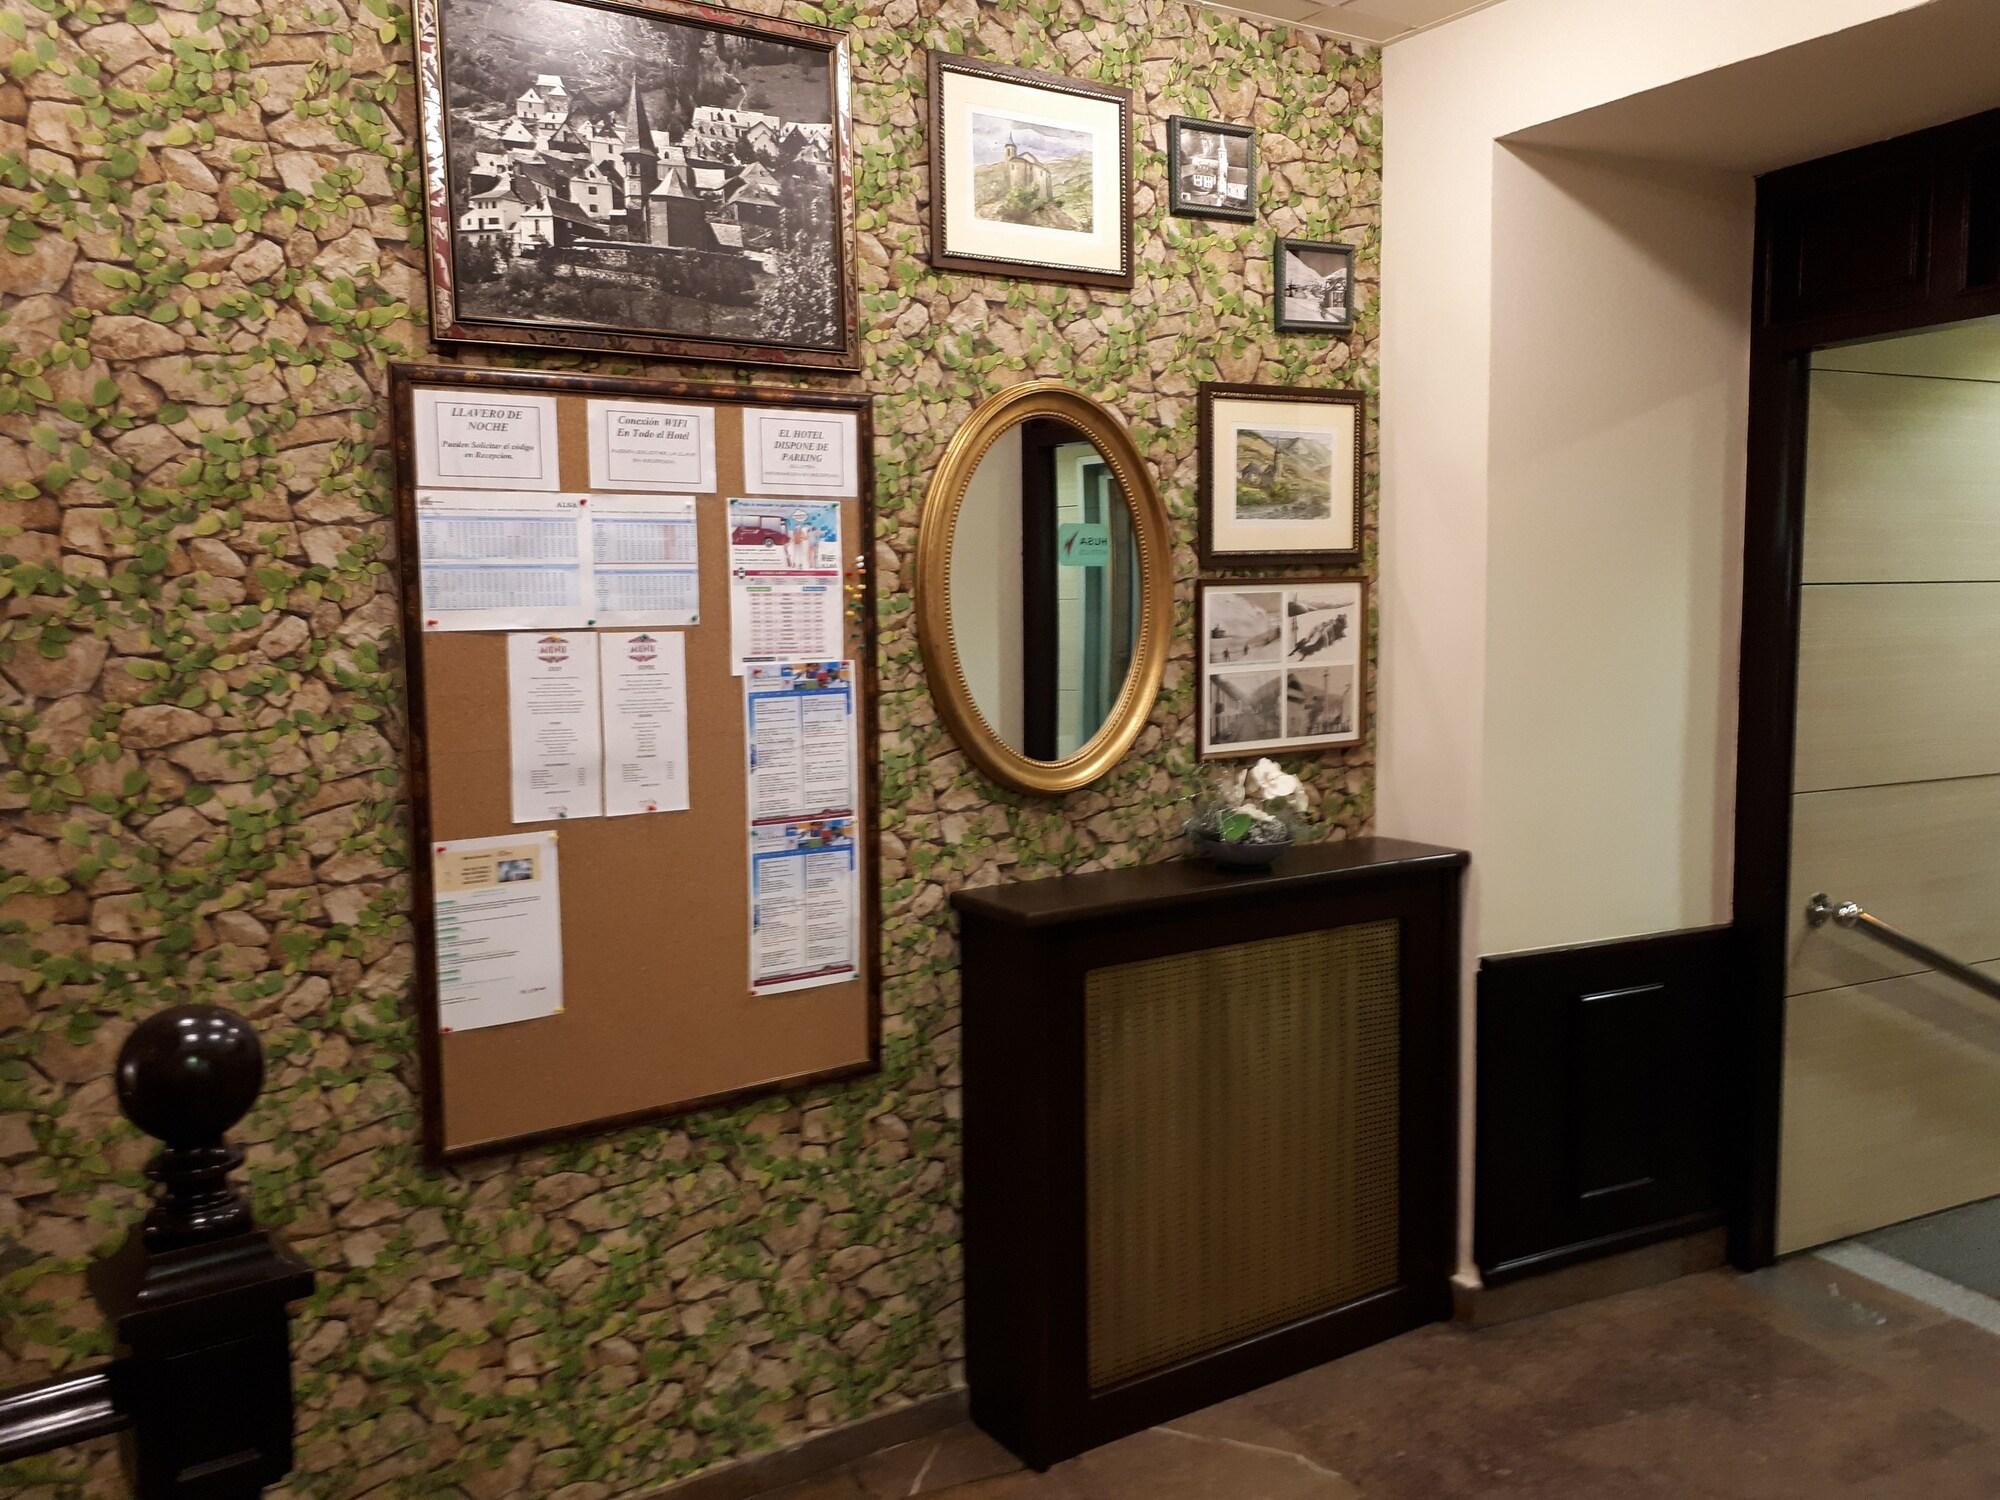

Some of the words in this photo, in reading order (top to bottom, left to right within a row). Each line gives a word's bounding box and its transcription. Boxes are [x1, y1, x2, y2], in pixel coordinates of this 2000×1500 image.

[452, 408, 505, 419] LLAVERO
[507, 410, 523, 419] DE
[467, 422, 509, 432] NOCHE
[618, 416, 659, 426] Conexión
[665, 418, 688, 428] WIFI
[617, 428, 630, 437] En
[633, 429, 654, 438] Todo
[656, 430, 664, 438] el
[667, 431, 690, 440] Hotel
[779, 429, 791, 438] EL
[793, 430, 824, 439] HOTEL
[774, 441, 815, 451] DISPONE
[816, 443, 829, 451] DE
[782, 453, 822, 463] PARKING
